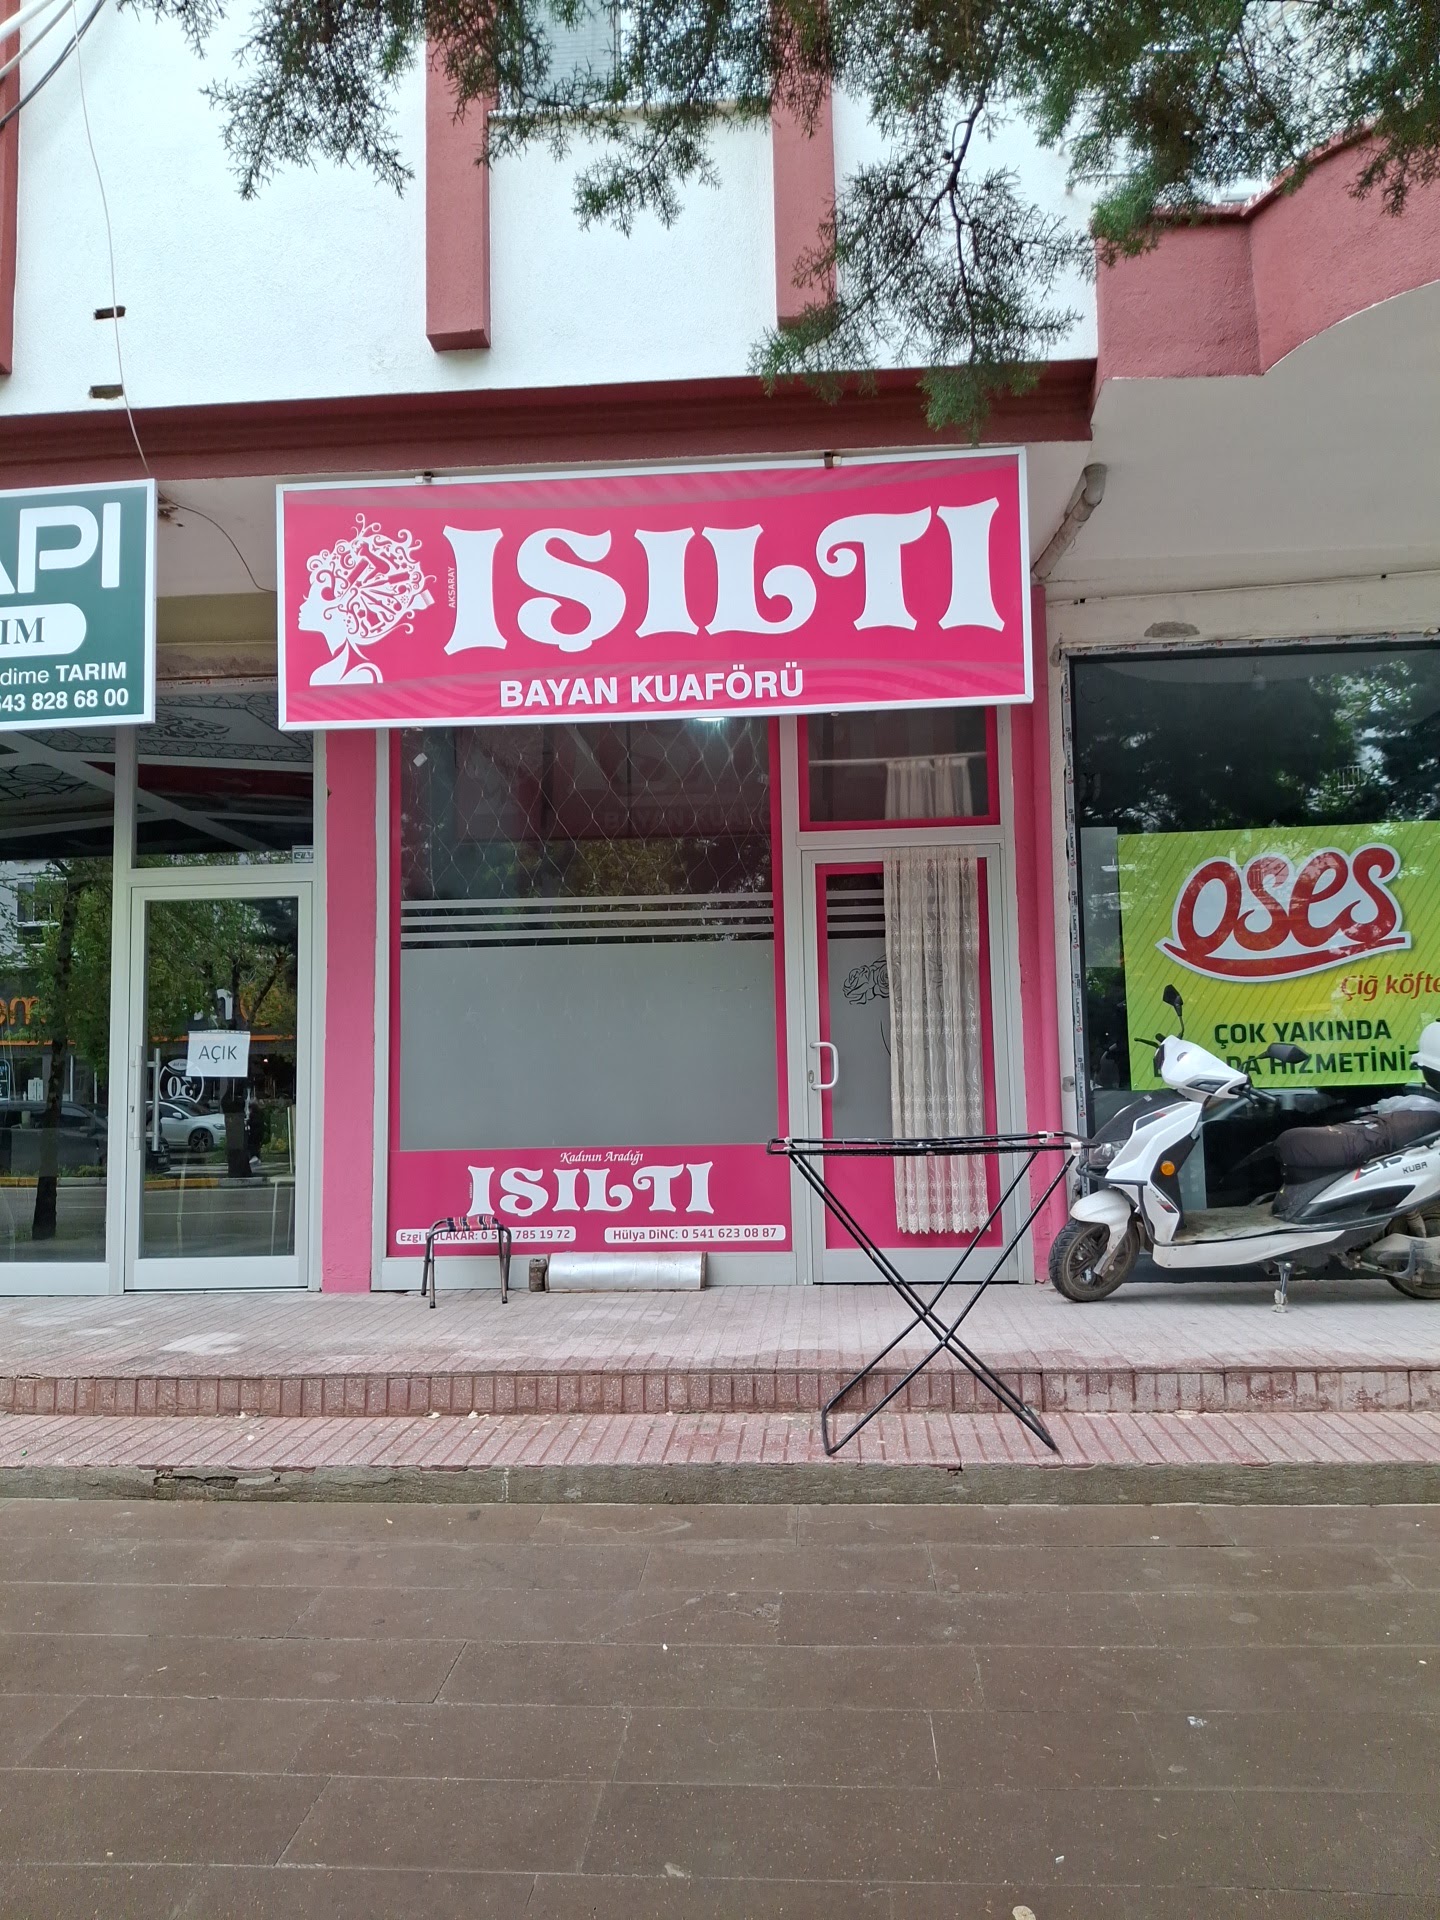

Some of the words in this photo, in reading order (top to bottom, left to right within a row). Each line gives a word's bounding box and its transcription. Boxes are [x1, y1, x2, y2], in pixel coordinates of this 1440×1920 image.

[0, 502, 121, 595] PI
[442, 497, 1006, 656] IŞILTI
[447, 566, 457, 609] AKSARAY
[55, 661, 126, 682] TARIM
[500, 677, 618, 707] BAYAN
[631, 662, 803, 703] KUAFÖRÜ
[0, 693, 26, 712] 43
[31, 691, 68, 711] 828
[74, 689, 98, 708] 68
[104, 687, 129, 707] 00
[1214, 1023, 1267, 1049] ÇOK
[1272, 1019, 1392, 1043] YAKINDA
[198, 1045, 238, 1064] AÇIK
[560, 1150, 602, 1165] Kadının
[604, 1149, 644, 1166] Aradığı
[467, 1161, 714, 1217] IŞILTI
[400, 1231, 422, 1243] Ezgi
[516, 1229, 536, 1239] 785
[540, 1228, 553, 1239] 19
[557, 1228, 570, 1239] 72
[613, 1229, 645, 1242] Hülya
[681, 1228, 689, 1239] 0
[692, 1227, 714, 1239] 541
[718, 1227, 740, 1238] 623
[744, 1227, 759, 1238] 08
[762, 1227, 777, 1238] 87
